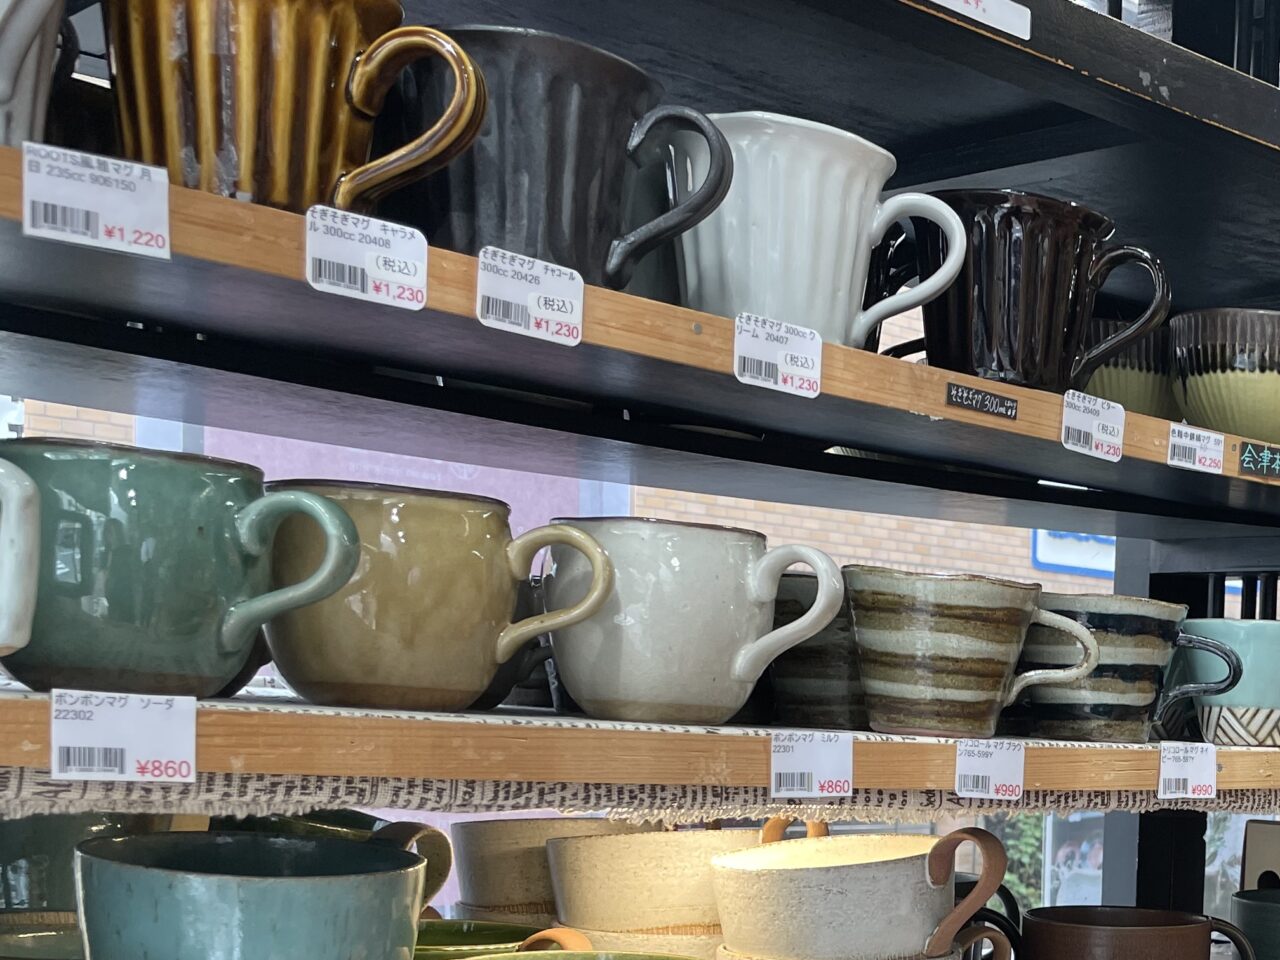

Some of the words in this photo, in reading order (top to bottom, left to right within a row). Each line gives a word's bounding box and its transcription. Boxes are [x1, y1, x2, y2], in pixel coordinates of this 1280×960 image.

[89, 173, 137, 193] 906150
[309, 208, 370, 230] そぎそぎマグ
[378, 223, 418, 241] キャラメ
[104, 224, 166, 249] ¥1,220
[323, 225, 357, 243] 300cc
[358, 234, 391, 250] 20408
[375, 255, 418, 276] (税込)
[481, 248, 536, 271] そぎそぎマグ
[481, 262, 509, 278] 300cc
[511, 268, 541, 285] 20426
[371, 281, 424, 303] ¥1,230
[537, 295, 574, 314] (税込)
[534, 316, 580, 340] ¥1,230
[737, 312, 782, 332] そぎそぎマグ
[784, 325, 809, 338] 300cc
[765, 333, 789, 345] 20407
[784, 352, 816, 370] (税込)
[781, 373, 819, 393] ¥1,230
[1094, 440, 1121, 457] ¥1,230
[1198, 456, 1222, 470] ¥2,250
[139, 697, 175, 711] ソーダ
[53, 708, 94, 722] 22302
[820, 734, 839, 743] ミルク
[772, 743, 795, 754] 22301
[136, 759, 192, 779] ¥860
[819, 780, 850, 794] ¥860
[994, 784, 1021, 797] ¥990
[1191, 784, 1213, 796] ¥990
